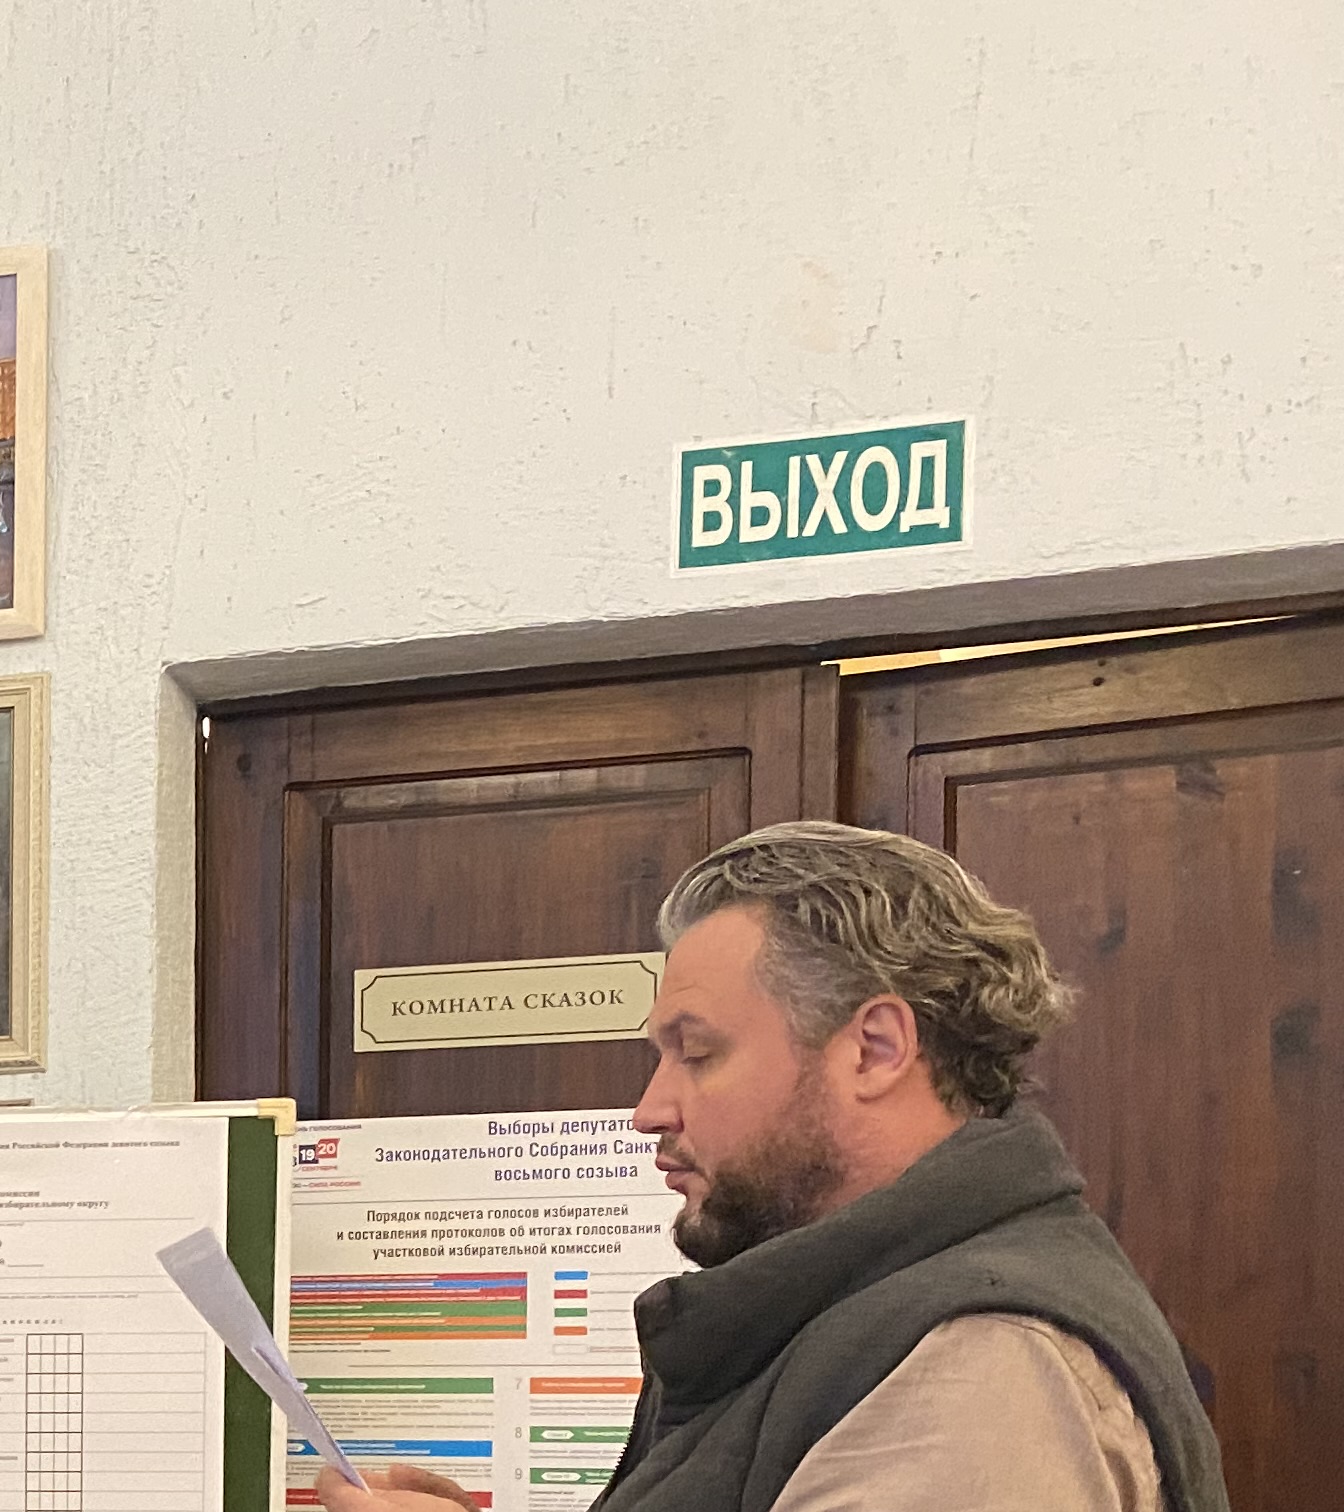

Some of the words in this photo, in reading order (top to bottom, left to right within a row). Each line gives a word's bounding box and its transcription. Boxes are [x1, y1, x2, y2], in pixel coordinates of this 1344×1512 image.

[691, 438, 951, 548] ВЫХОД
[391, 994, 515, 1017] КОМНАТА
[523, 988, 625, 1010] СКАЗОК
[488, 1120, 555, 1137] Выборы
[560, 1118, 635, 1136] депутато
[300, 1148, 316, 1161] 19
[318, 1143, 337, 1155] 20
[374, 1144, 524, 1163] Законодательного
[529, 1141, 608, 1160] Собрания
[494, 1167, 571, 1182] восьмого
[576, 1165, 638, 1179] созыва
[366, 1210, 421, 1224] Порядок
[424, 1209, 484, 1222] подсчета
[487, 1208, 540, 1220] голосов
[543, 1205, 629, 1220] избирателей
[336, 1231, 344, 1241] и
[347, 1229, 428, 1241] составления
[431, 1227, 506, 1241] протоколов
[509, 1226, 525, 1238] об
[529, 1225, 573, 1237] итогах
[576, 1224, 662, 1236] голосования
[372, 1245, 445, 1261] участковой
[448, 1242, 547, 1259] избирательной
[550, 1241, 623, 1255] комиссией
